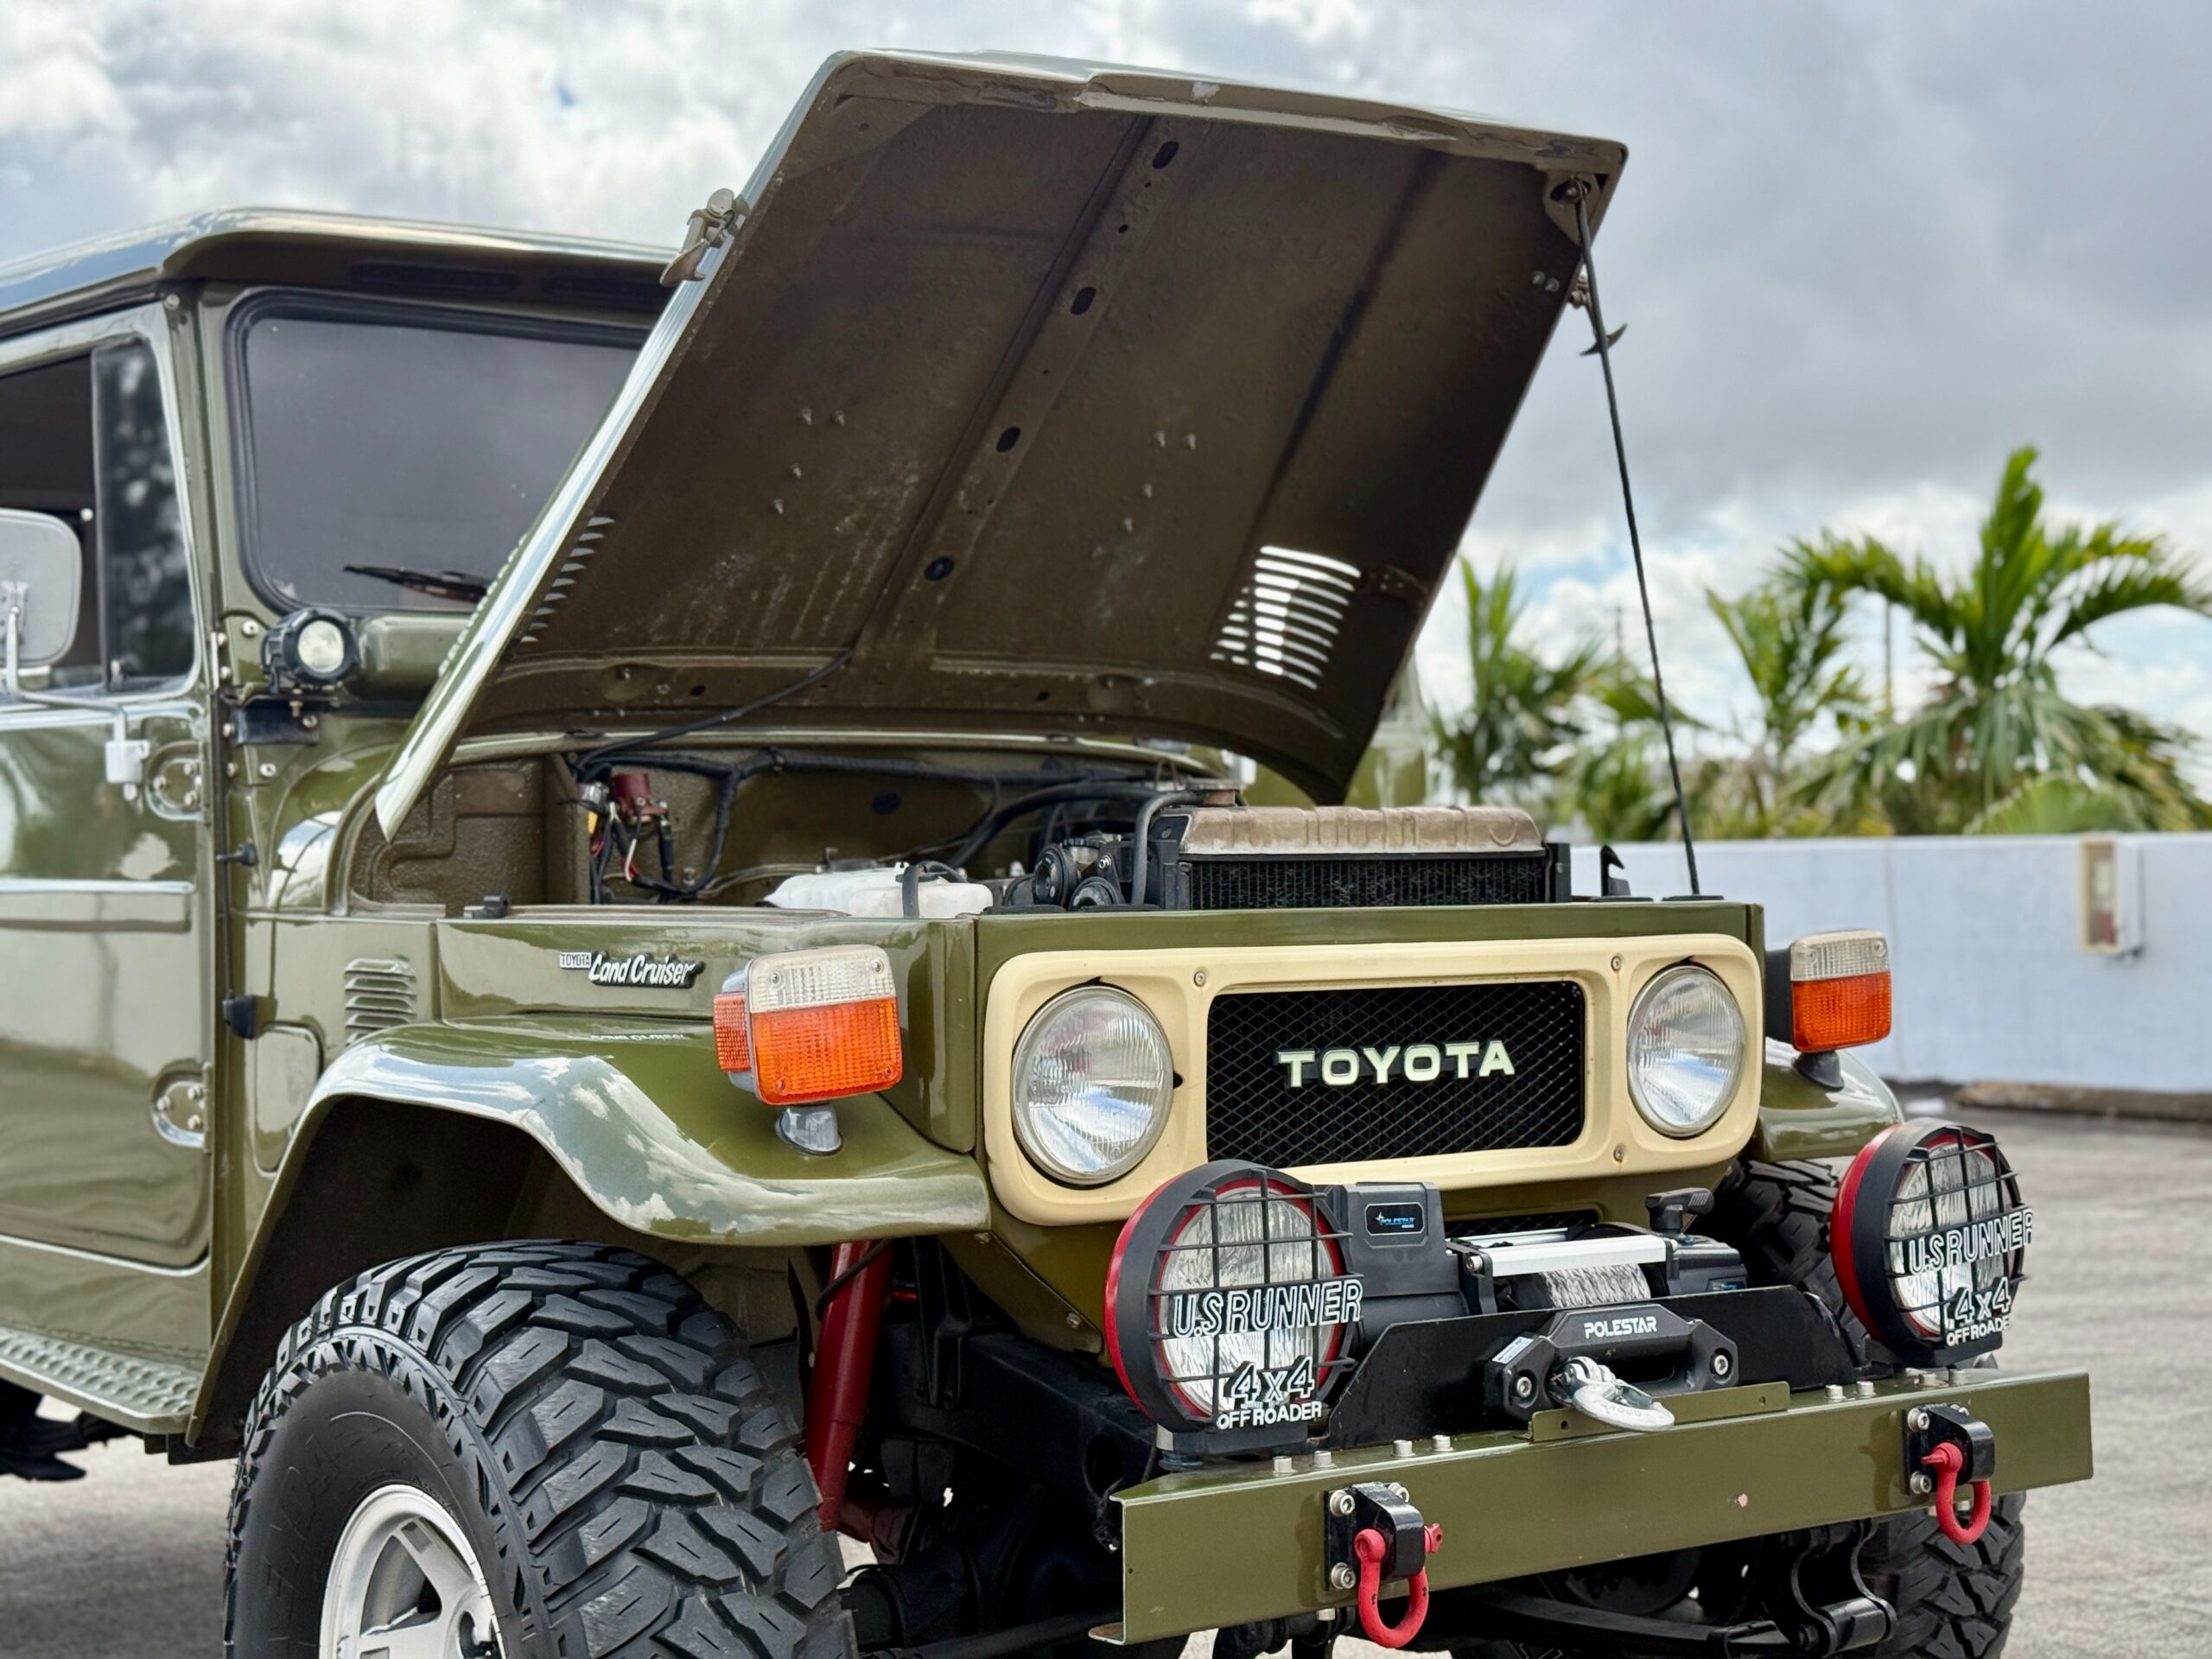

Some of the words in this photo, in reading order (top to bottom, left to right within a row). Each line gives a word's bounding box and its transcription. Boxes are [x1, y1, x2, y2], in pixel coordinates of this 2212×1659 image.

[561, 952, 591, 968] TOYOTA
[588, 954, 632, 983] Land
[630, 955, 696, 985] Cruiser
[1277, 1039, 1515, 1088] TOYOTA
[1584, 1316, 1658, 1339] POLESTAR
